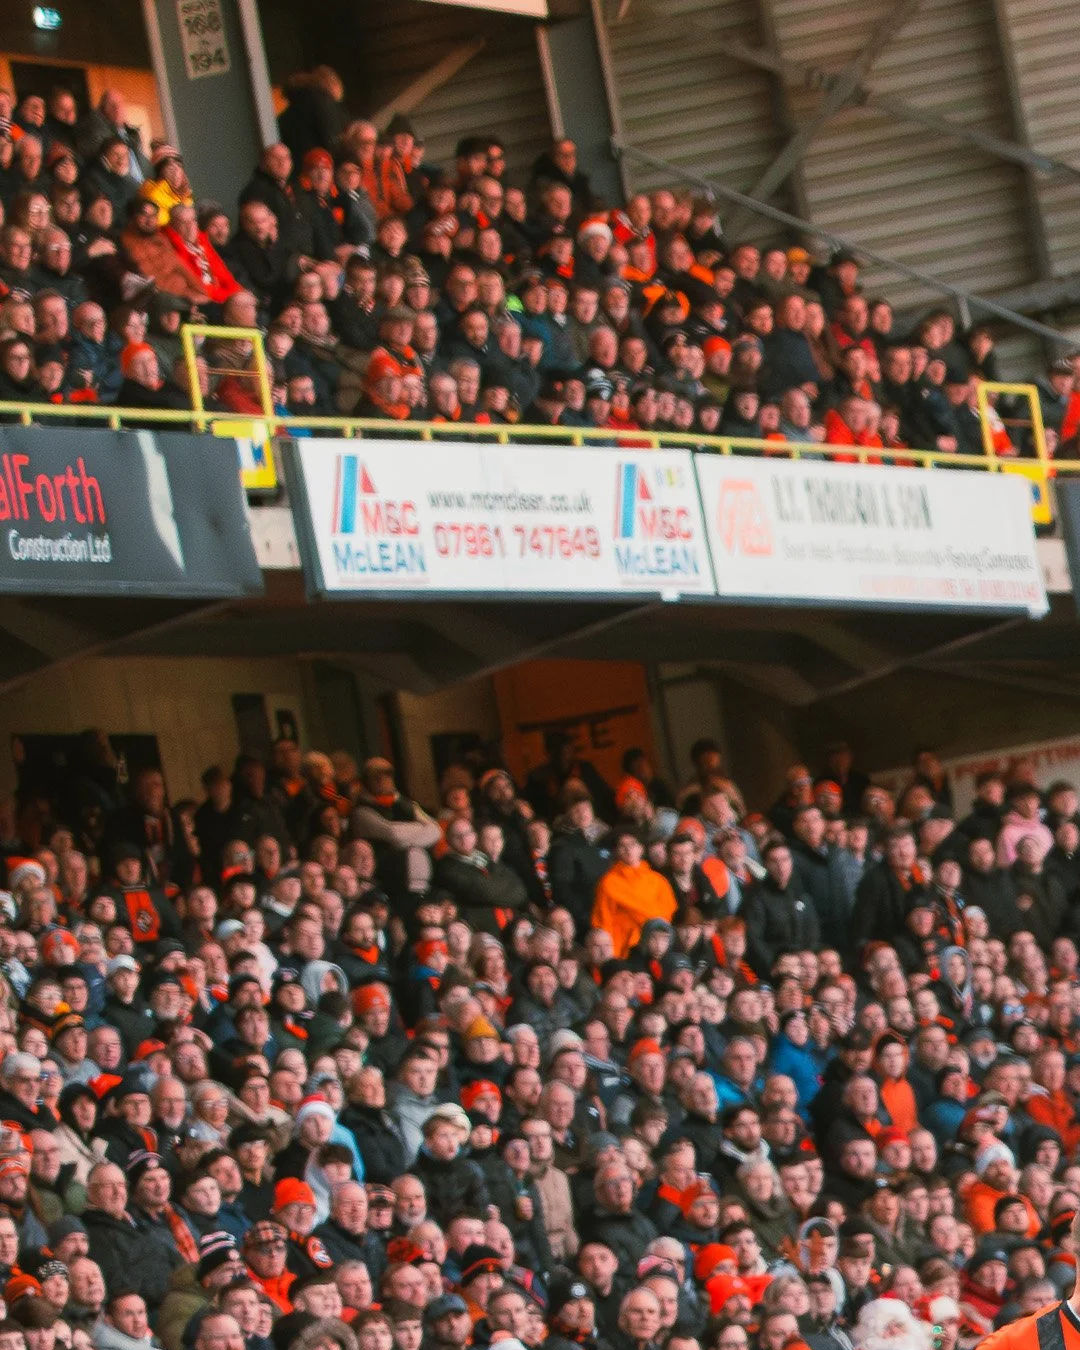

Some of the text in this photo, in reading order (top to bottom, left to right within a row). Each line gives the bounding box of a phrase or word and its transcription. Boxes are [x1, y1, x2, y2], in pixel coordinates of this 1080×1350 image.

[9, 529, 112, 562] Construction Ltd
[332, 542, 428, 574] McLEAN
[614, 545, 700, 576] McLEAN
